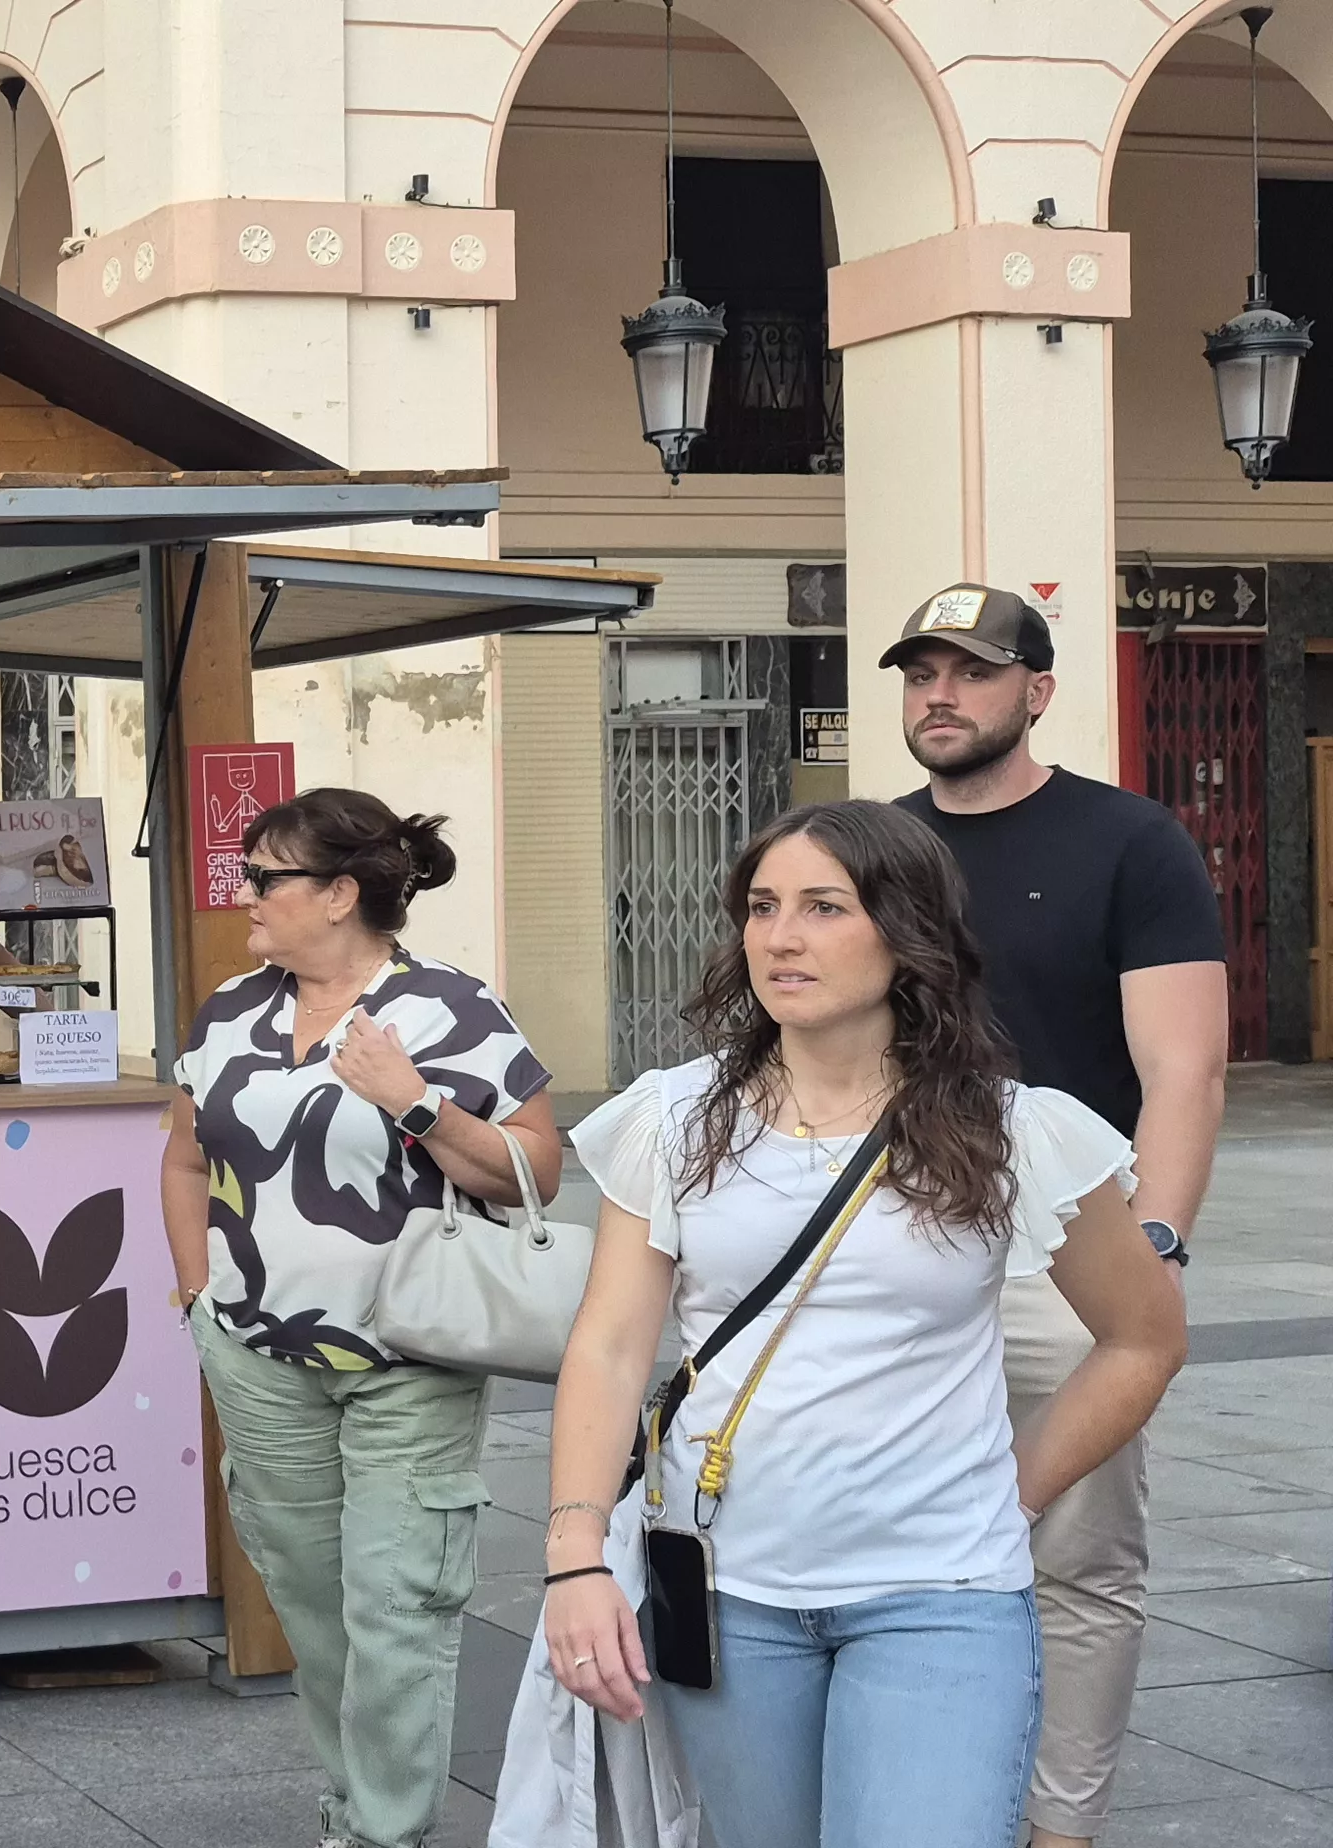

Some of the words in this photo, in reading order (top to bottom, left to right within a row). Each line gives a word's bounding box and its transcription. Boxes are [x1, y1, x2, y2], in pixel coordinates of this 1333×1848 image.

[804, 713, 819, 730] SE
[9, 810, 55, 832] RUSO
[208, 892, 228, 906] DE
[43, 1013, 88, 1026] TARTA
[36, 1033, 54, 1045] DE
[56, 1031, 102, 1046] QUESO
[22, 1477, 137, 1521] dulce
